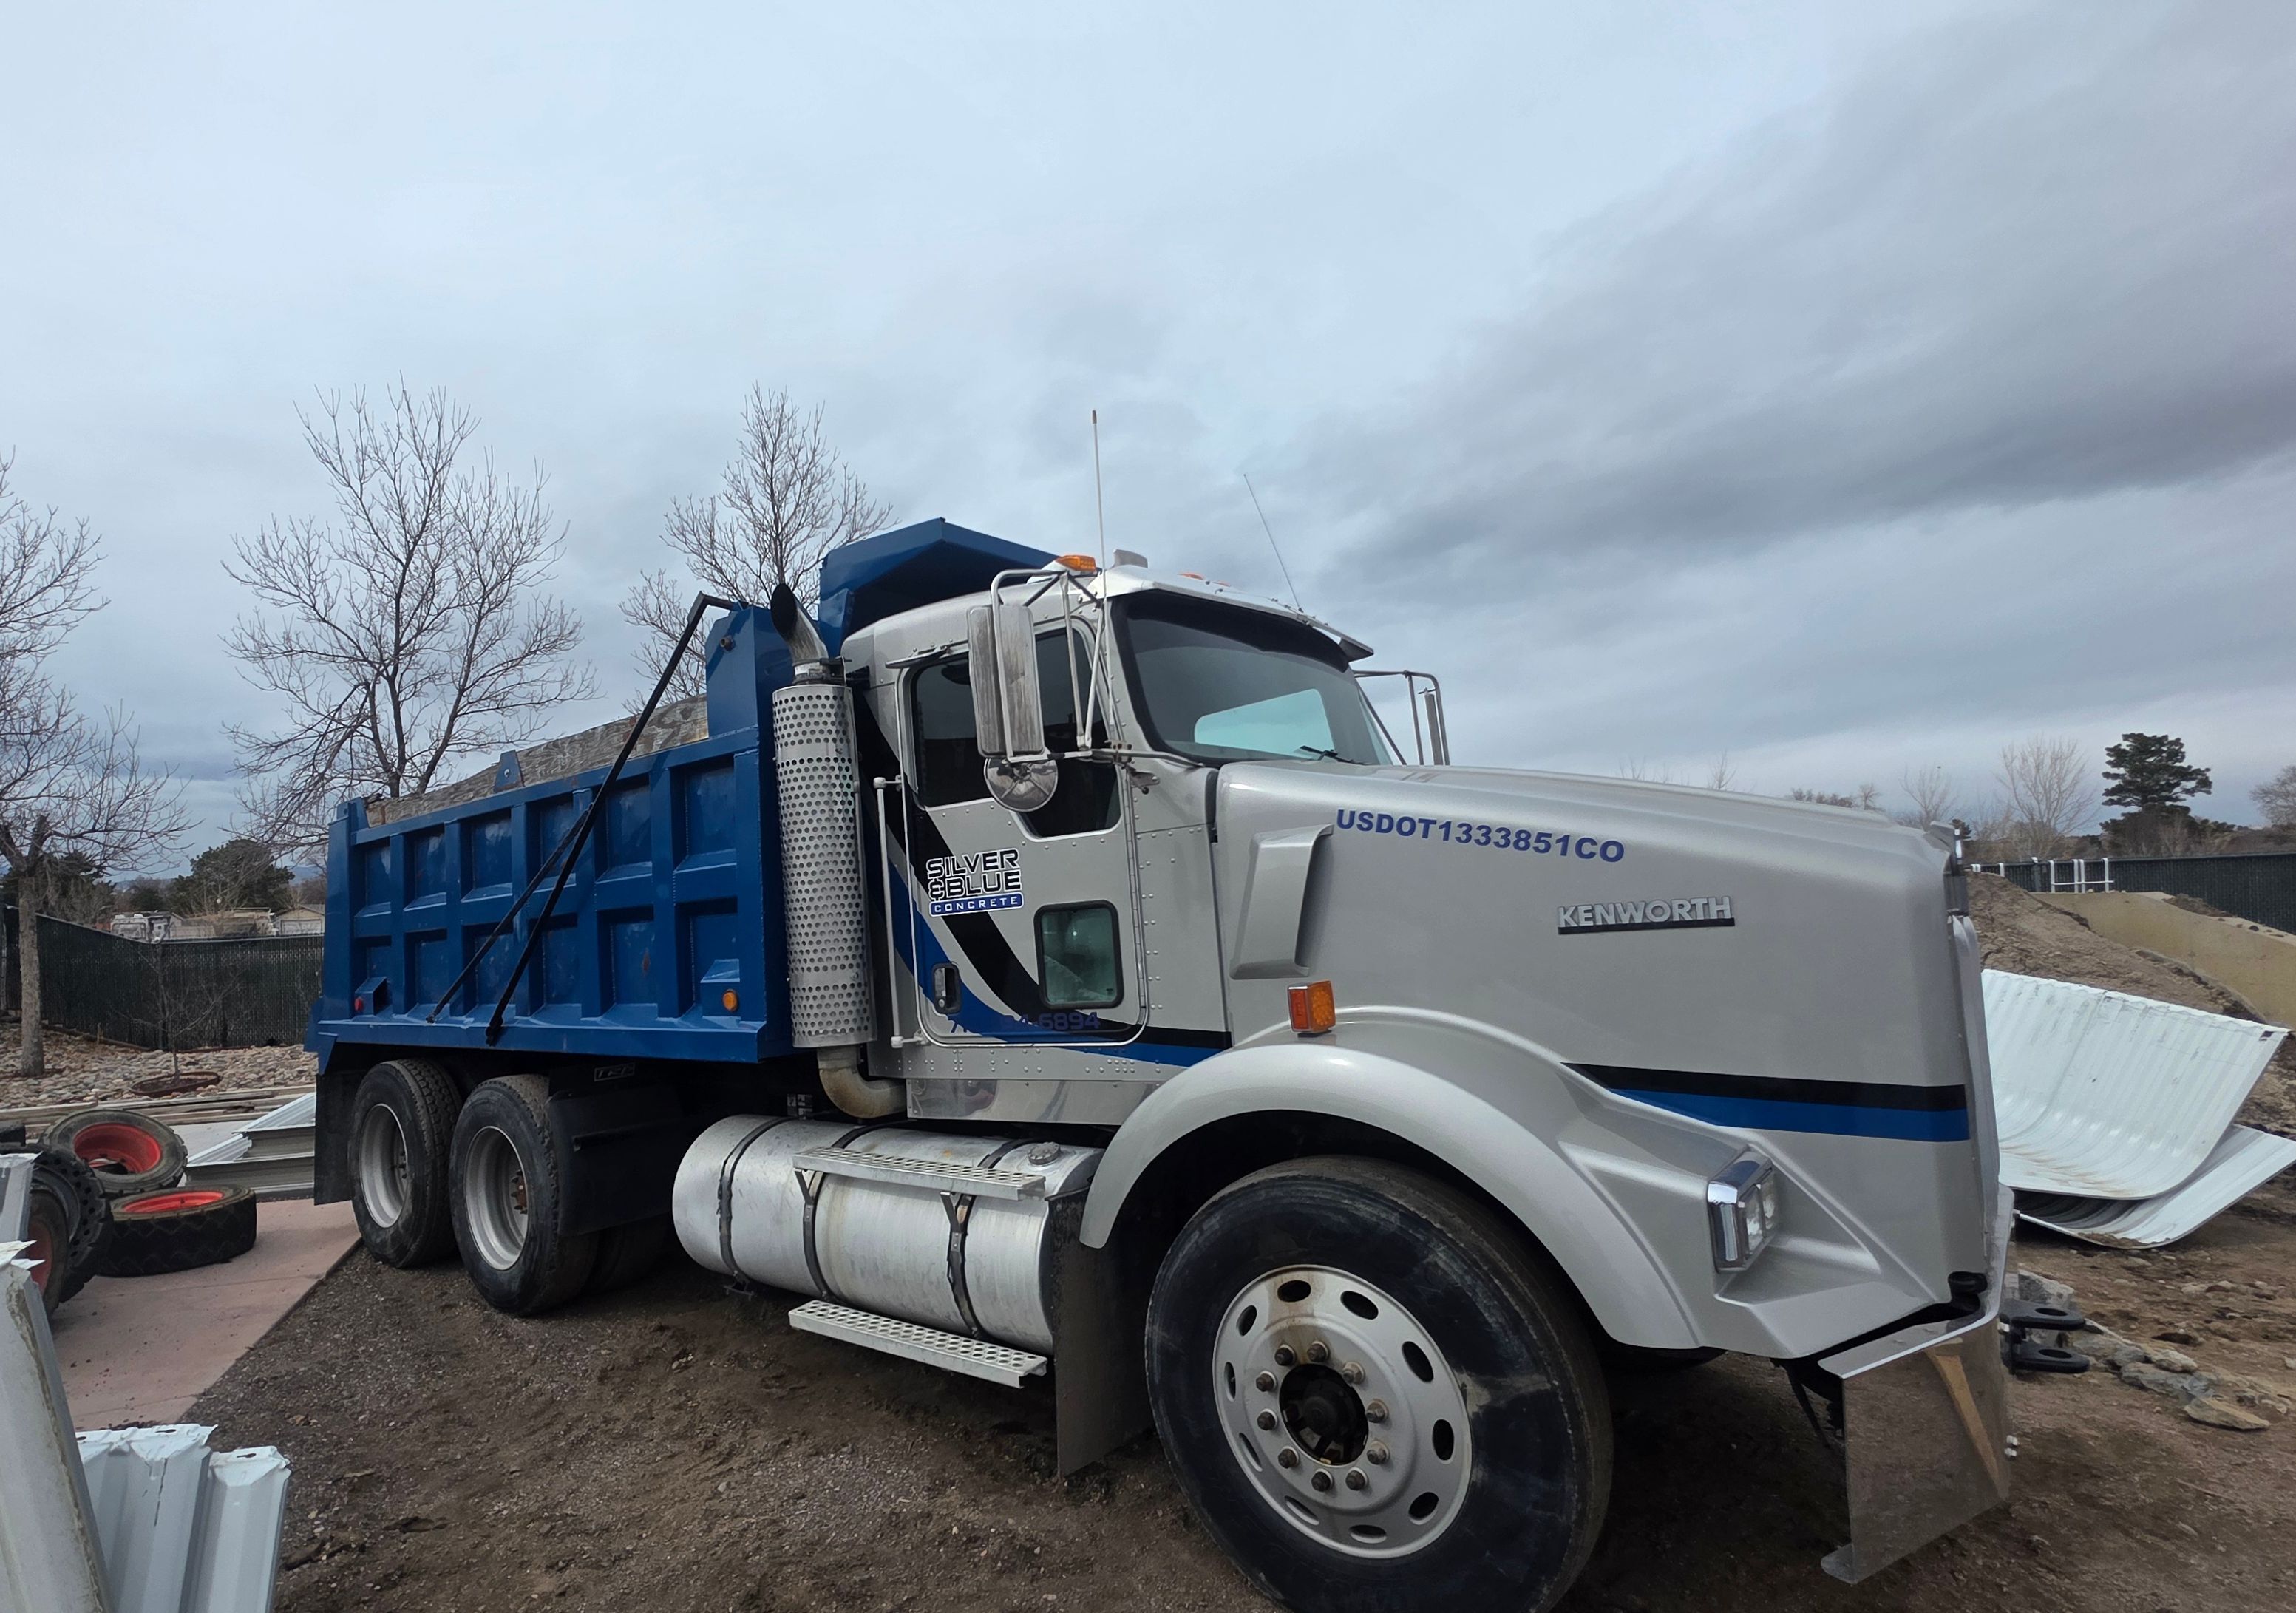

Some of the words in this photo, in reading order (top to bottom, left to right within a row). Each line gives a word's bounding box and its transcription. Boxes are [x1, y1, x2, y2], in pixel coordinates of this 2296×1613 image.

[1336, 809, 1626, 863] USDOT1333851CO
[926, 848, 1019, 879] SILVER
[928, 870, 1022, 901] &BLUE
[934, 896, 1019, 913] CONCRETE
[1558, 895, 1733, 928] KENWORTH
